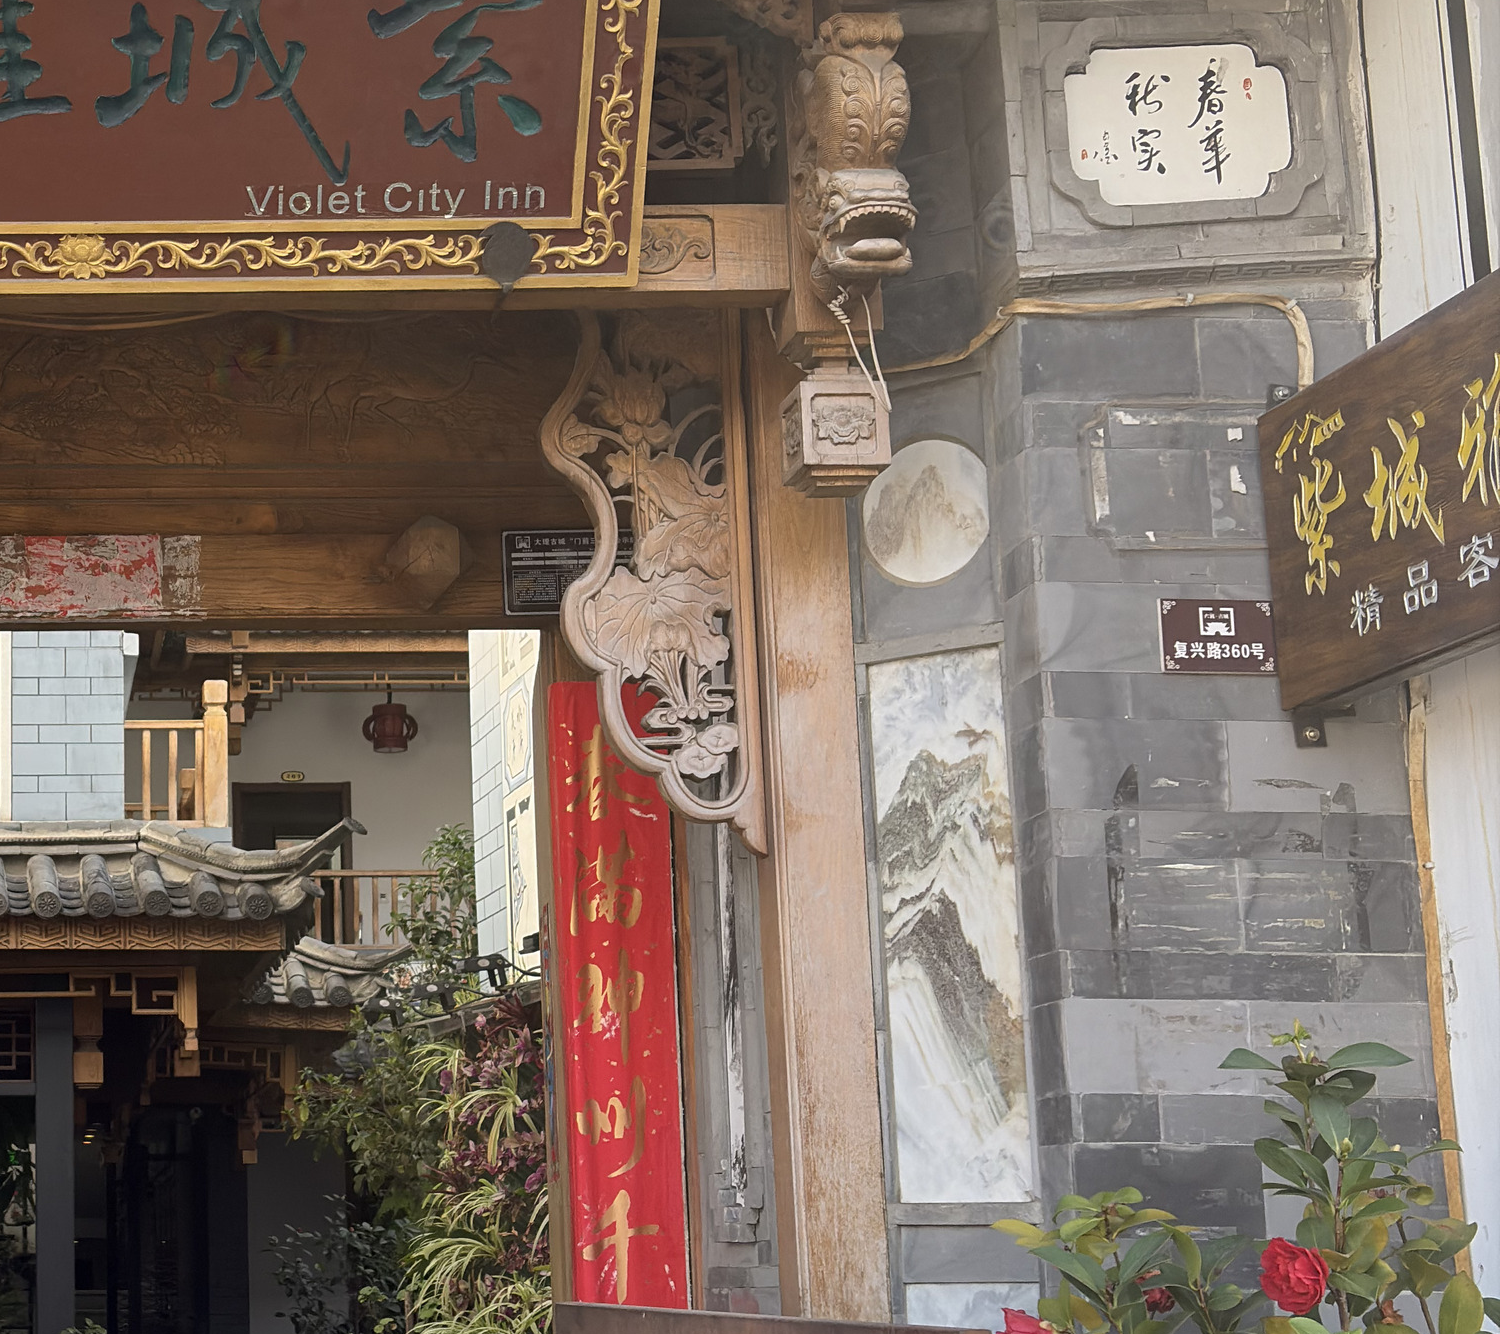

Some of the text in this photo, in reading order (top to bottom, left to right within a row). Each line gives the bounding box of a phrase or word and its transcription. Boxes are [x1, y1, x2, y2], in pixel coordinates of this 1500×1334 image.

[246, 180, 546, 218] Violet City Inn
[1351, 532, 1499, 637] 精品客
[1173, 641, 1266, 660] 复兴路360号
